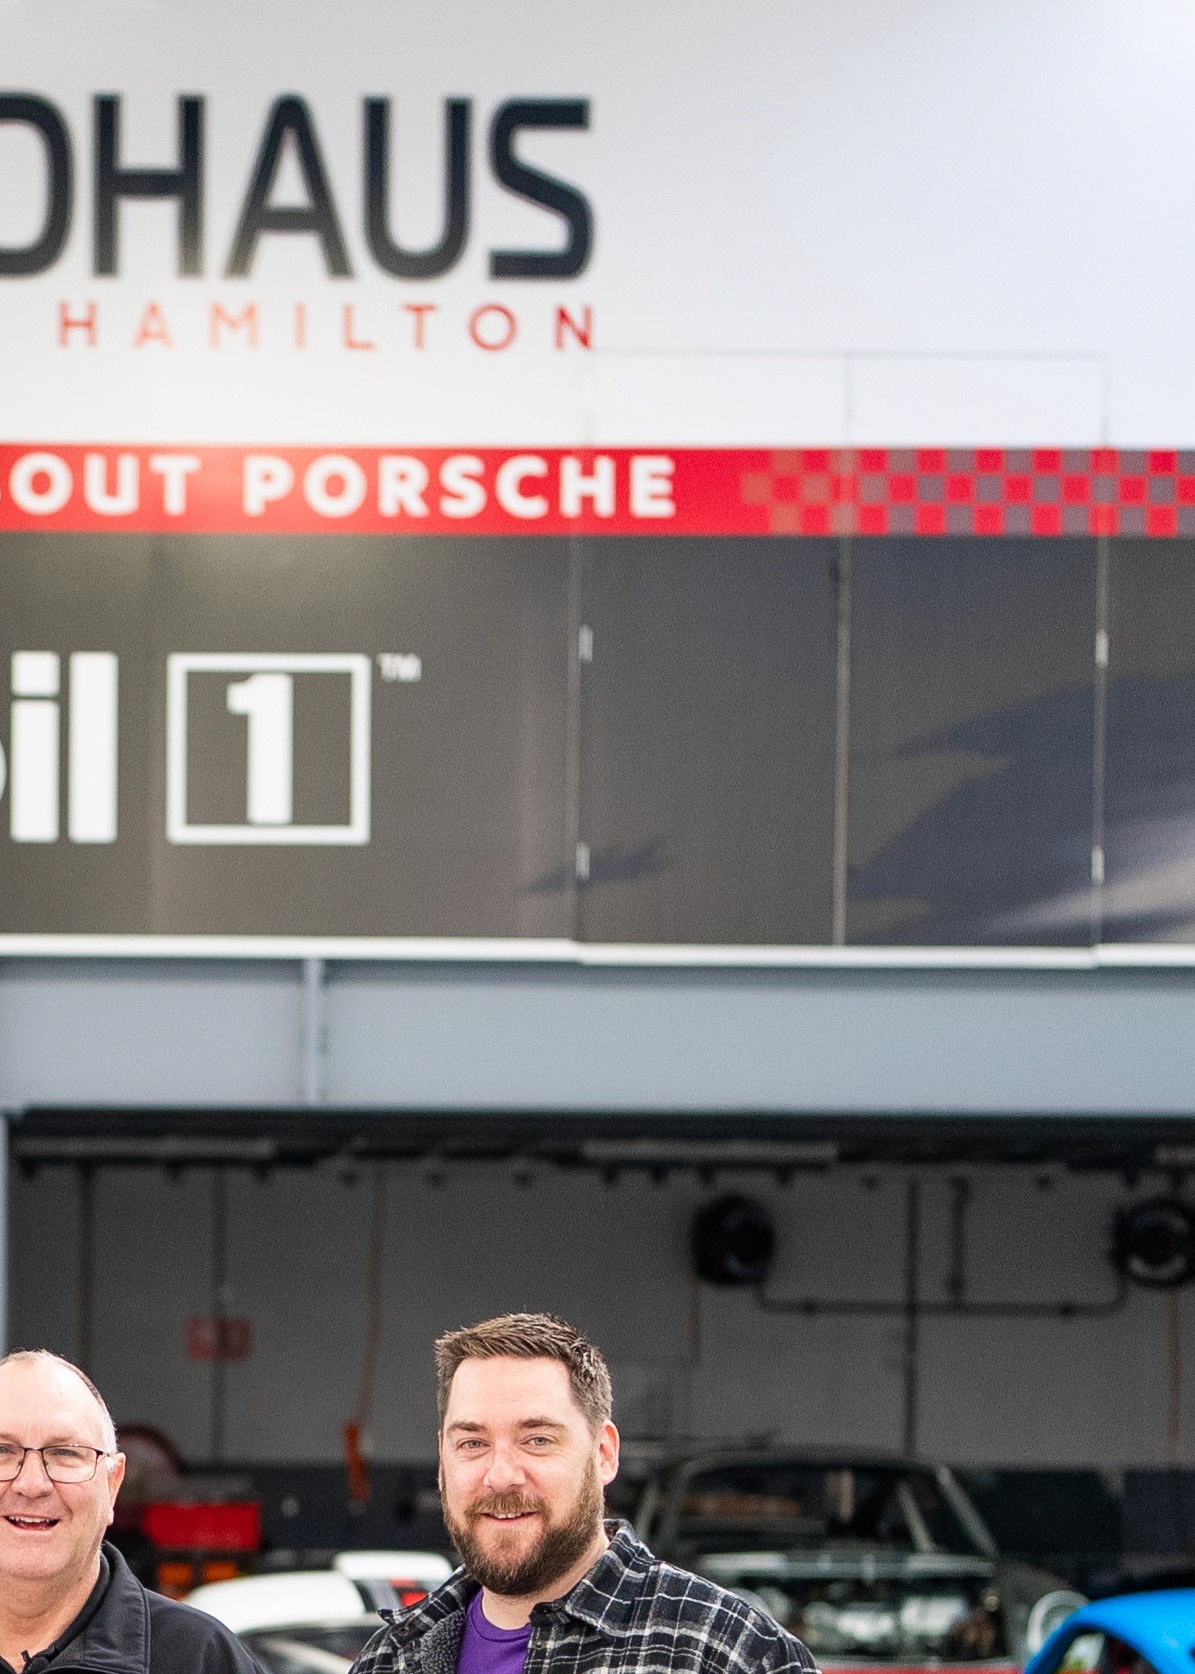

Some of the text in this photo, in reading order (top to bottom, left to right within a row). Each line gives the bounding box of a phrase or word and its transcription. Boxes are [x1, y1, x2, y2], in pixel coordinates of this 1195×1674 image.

[57, 301, 594, 354] HAMILTON
[241, 453, 677, 521] PORSCHE
[226, 671, 295, 826] 1
